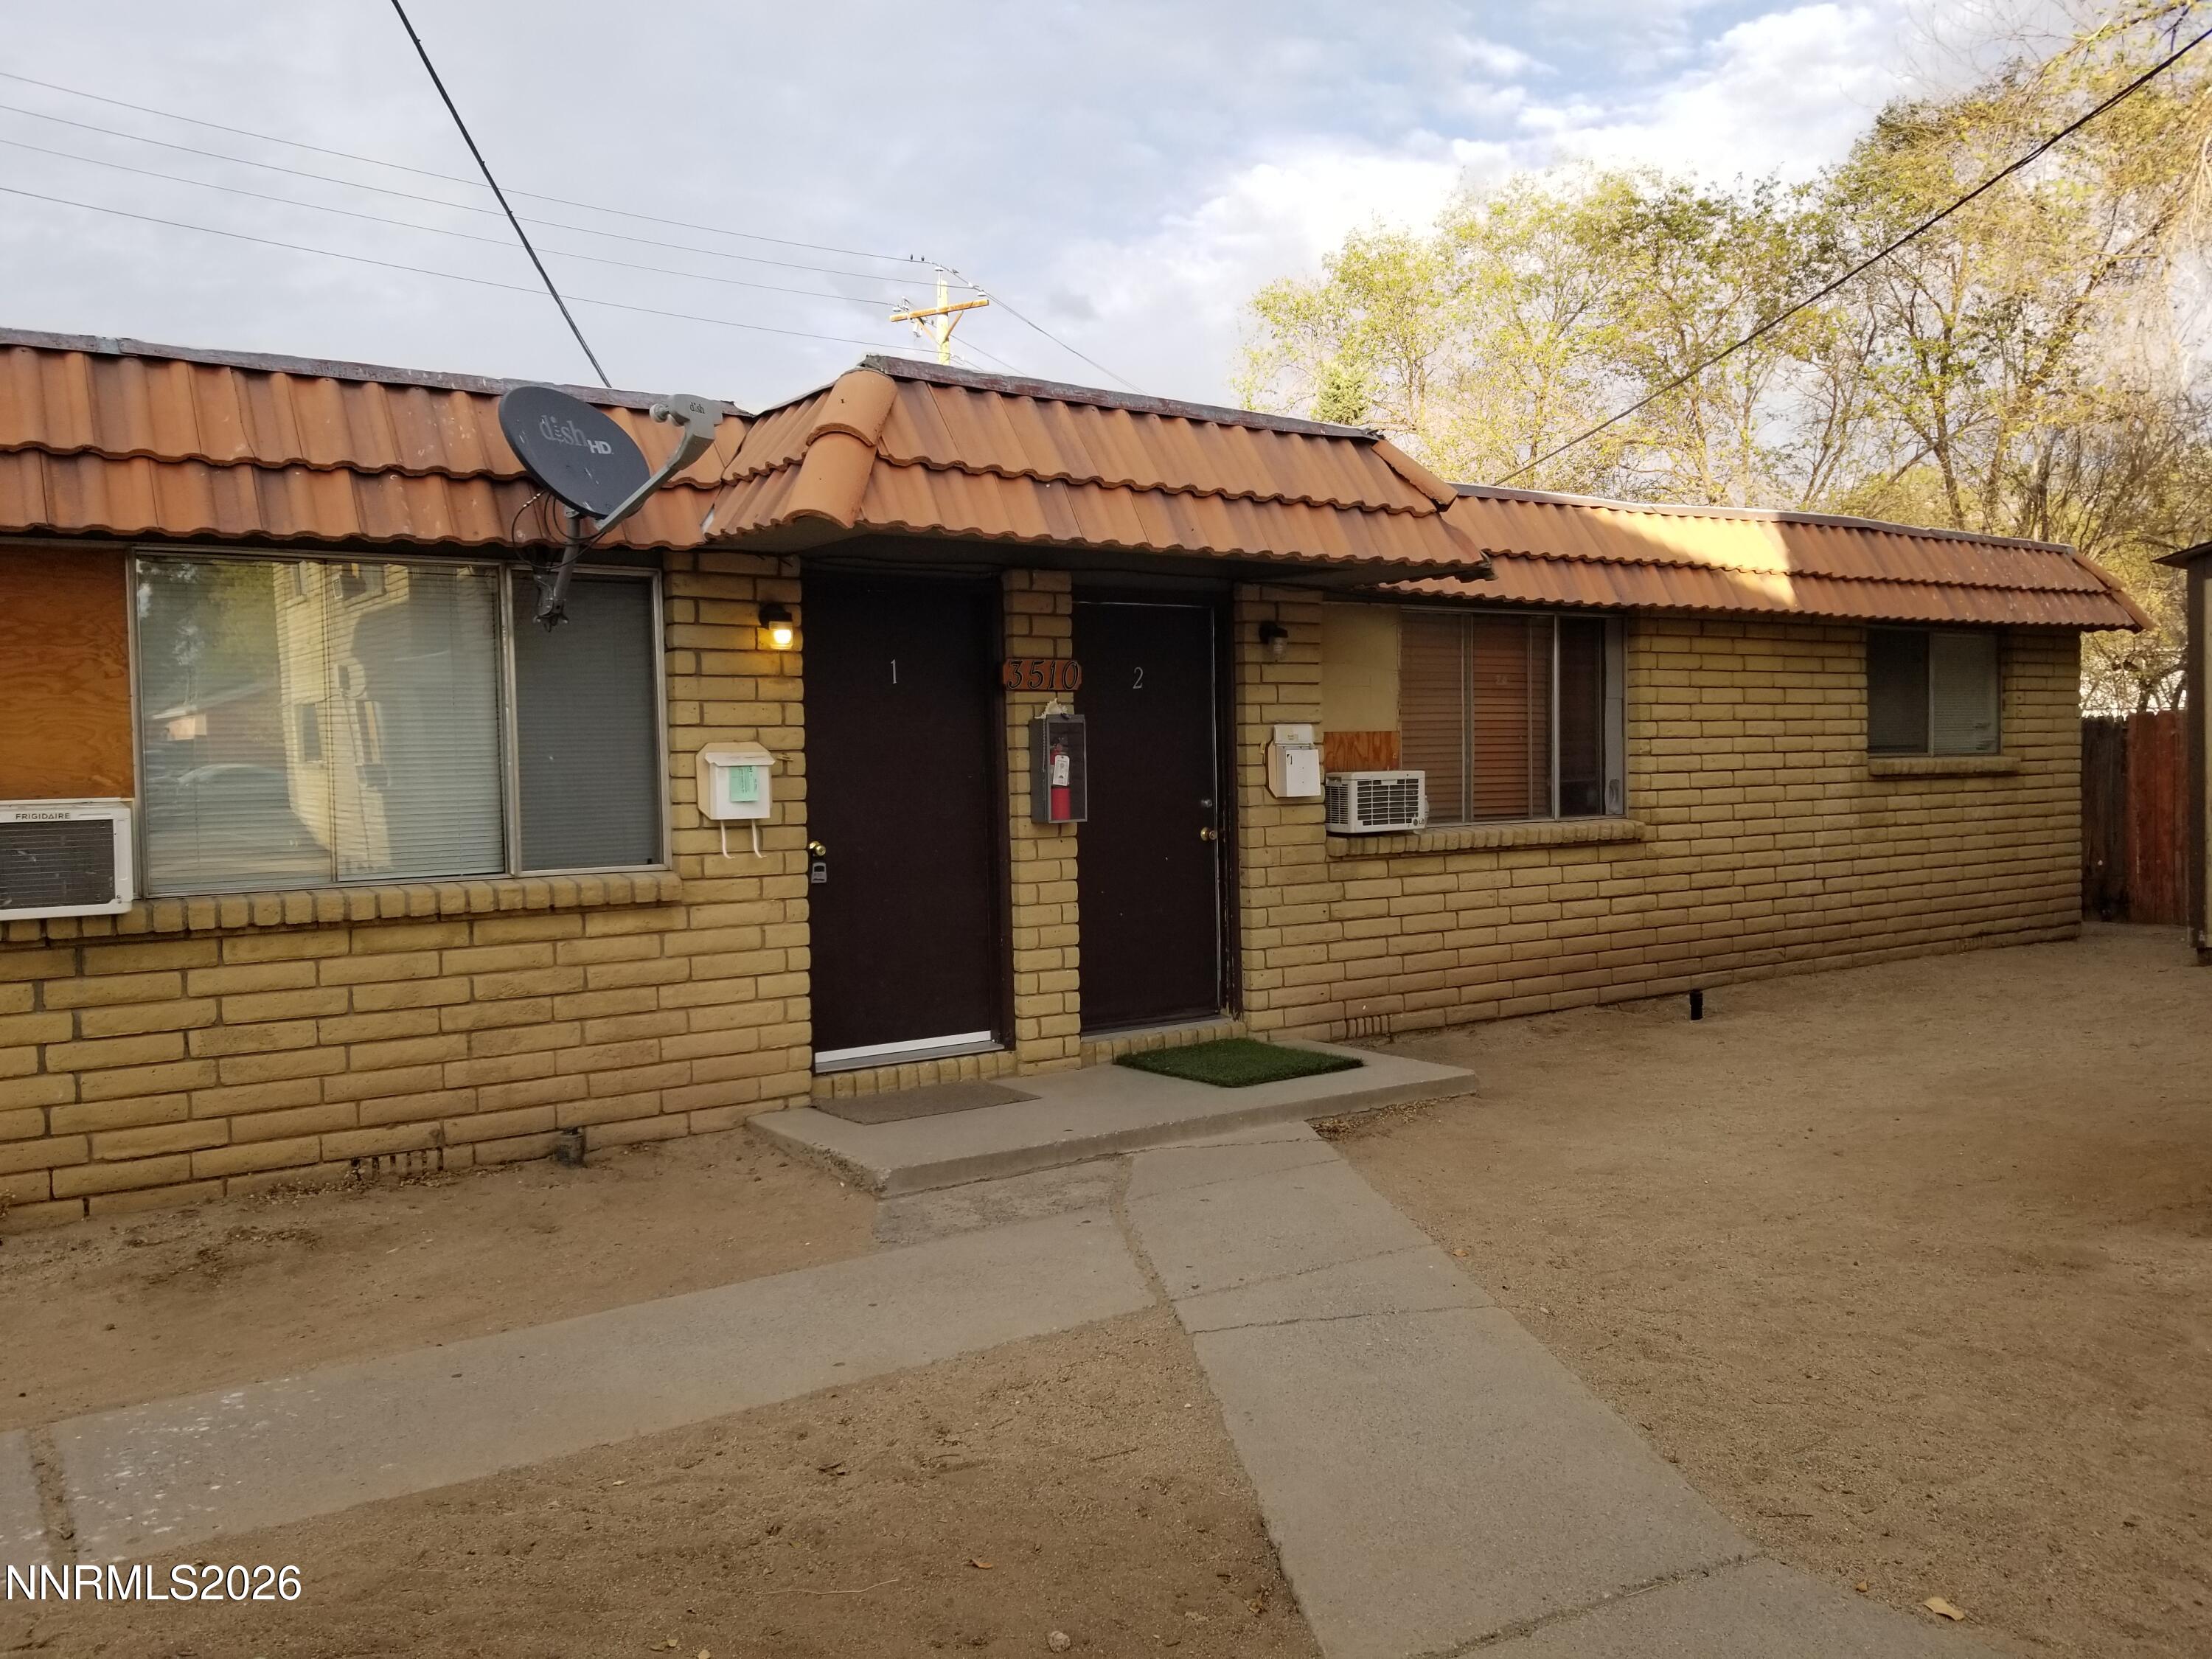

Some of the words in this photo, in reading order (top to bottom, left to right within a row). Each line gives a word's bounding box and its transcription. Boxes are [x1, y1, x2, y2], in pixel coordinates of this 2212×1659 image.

[689, 402, 706, 414] dish
[539, 414, 588, 446] dish
[587, 440, 613, 454] HD
[891, 659, 897, 684] 1
[1007, 659, 1079, 690] 3510
[1133, 667, 1143, 689] 2
